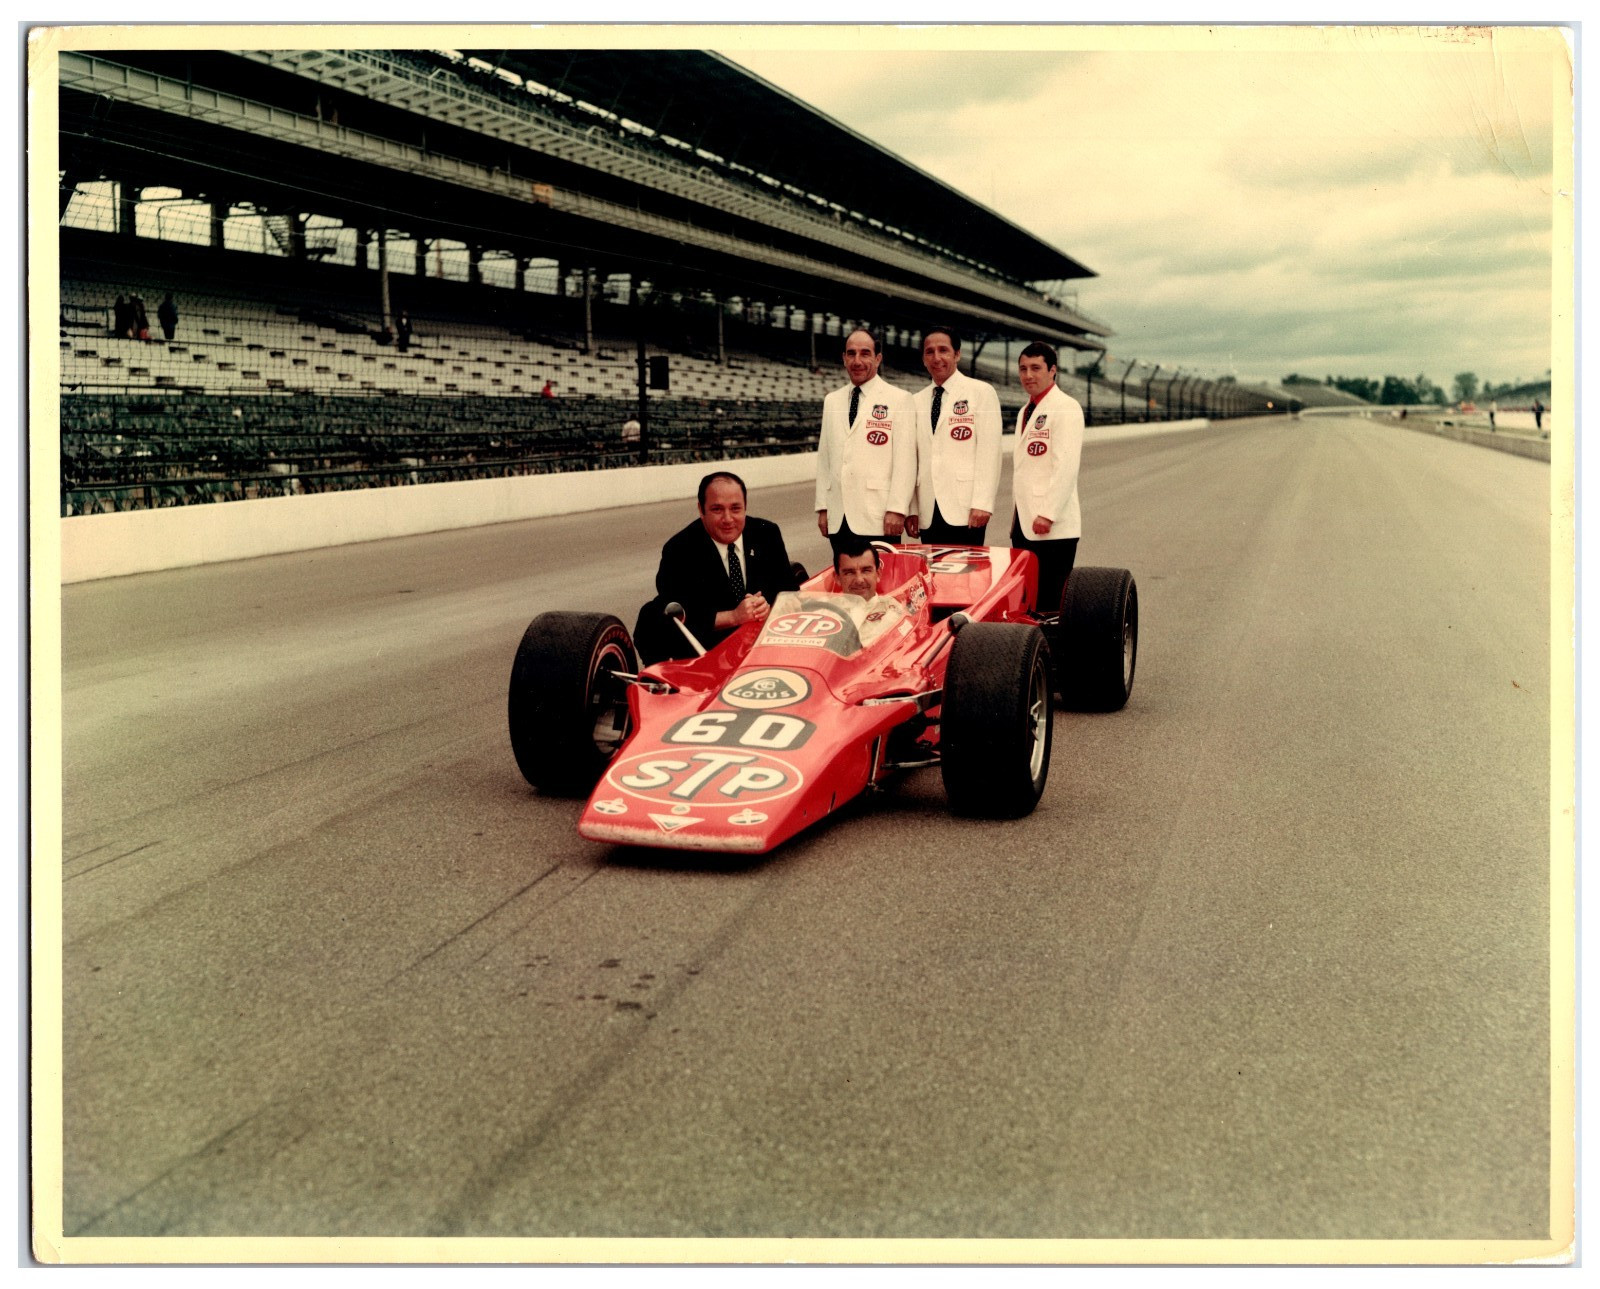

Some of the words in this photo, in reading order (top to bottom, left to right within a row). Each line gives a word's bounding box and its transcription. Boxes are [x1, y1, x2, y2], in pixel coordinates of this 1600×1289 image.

[869, 432, 886, 444] STP
[953, 427, 970, 439] STP
[1029, 442, 1045, 455] STP
[773, 615, 836, 635] STP
[733, 689, 790, 699] LOTUS
[670, 712, 806, 749] 60
[621, 752, 788, 799] STP
